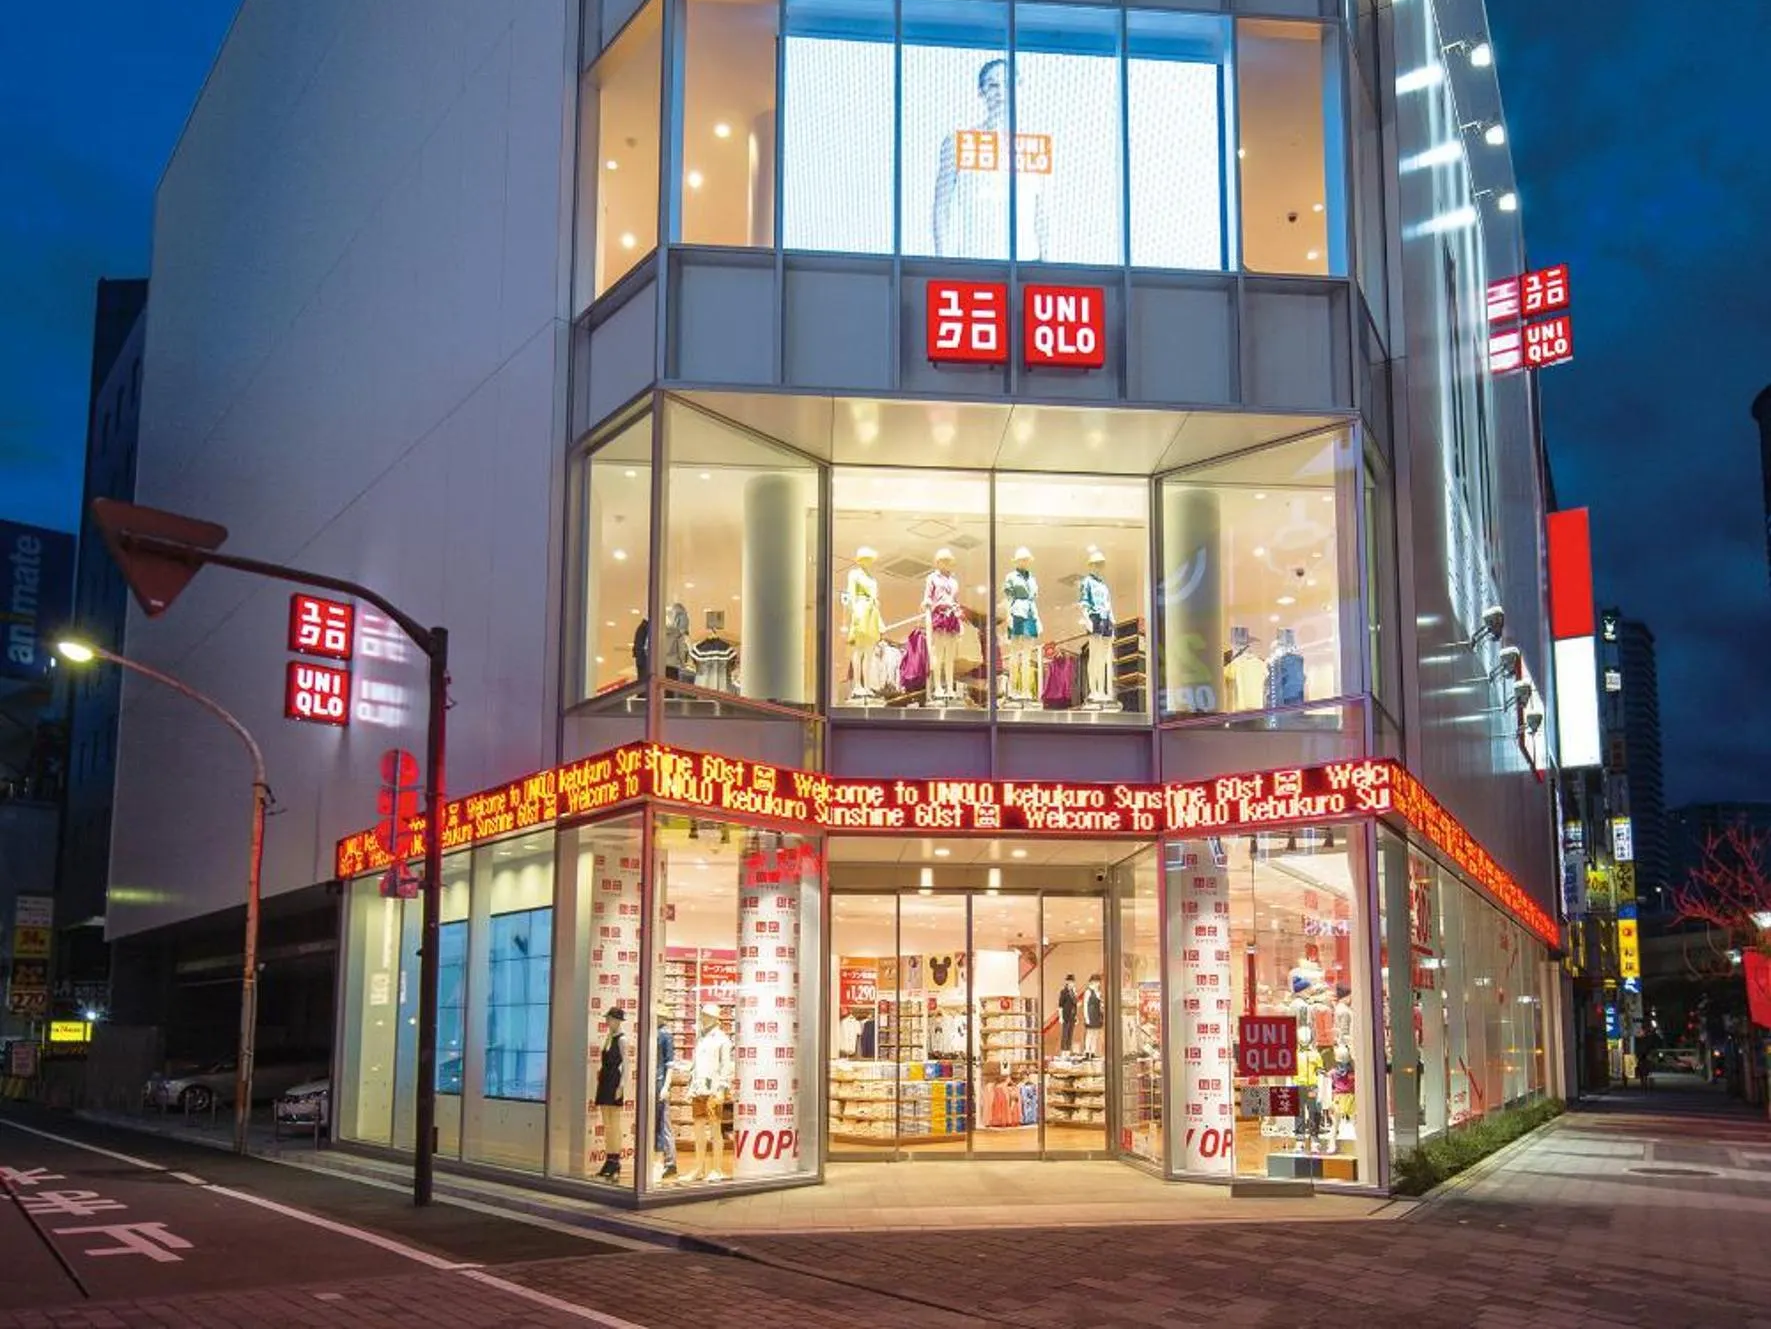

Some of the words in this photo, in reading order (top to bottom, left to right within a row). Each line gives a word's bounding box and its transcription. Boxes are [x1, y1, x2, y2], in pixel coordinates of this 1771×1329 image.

[1033, 294, 1090, 323] UNI
[1034, 325, 1096, 357] QLO
[1527, 321, 1563, 343] UNI
[1527, 338, 1568, 362] QLO
[8, 534, 42, 665] animate
[296, 668, 341, 695] UNI
[296, 690, 344, 716] QLO
[568, 780, 619, 812] Welcome
[626, 773, 639, 797] to
[722, 780, 807, 820] Ikebukuro
[814, 799, 905, 828] Sunshine
[915, 803, 963, 828] 60st
[1025, 804, 1121, 829] Welcome
[1131, 807, 1154, 830] to
[1239, 793, 1345, 823] Ikebukuro
[793, 771, 884, 805] Welcome
[895, 784, 918, 804] to
[929, 781, 994, 804] UNIQLO
[1004, 782, 1104, 807] Ikebukuro
[1245, 1023, 1287, 1044] UNI
[1246, 1048, 1292, 1072] QLO
